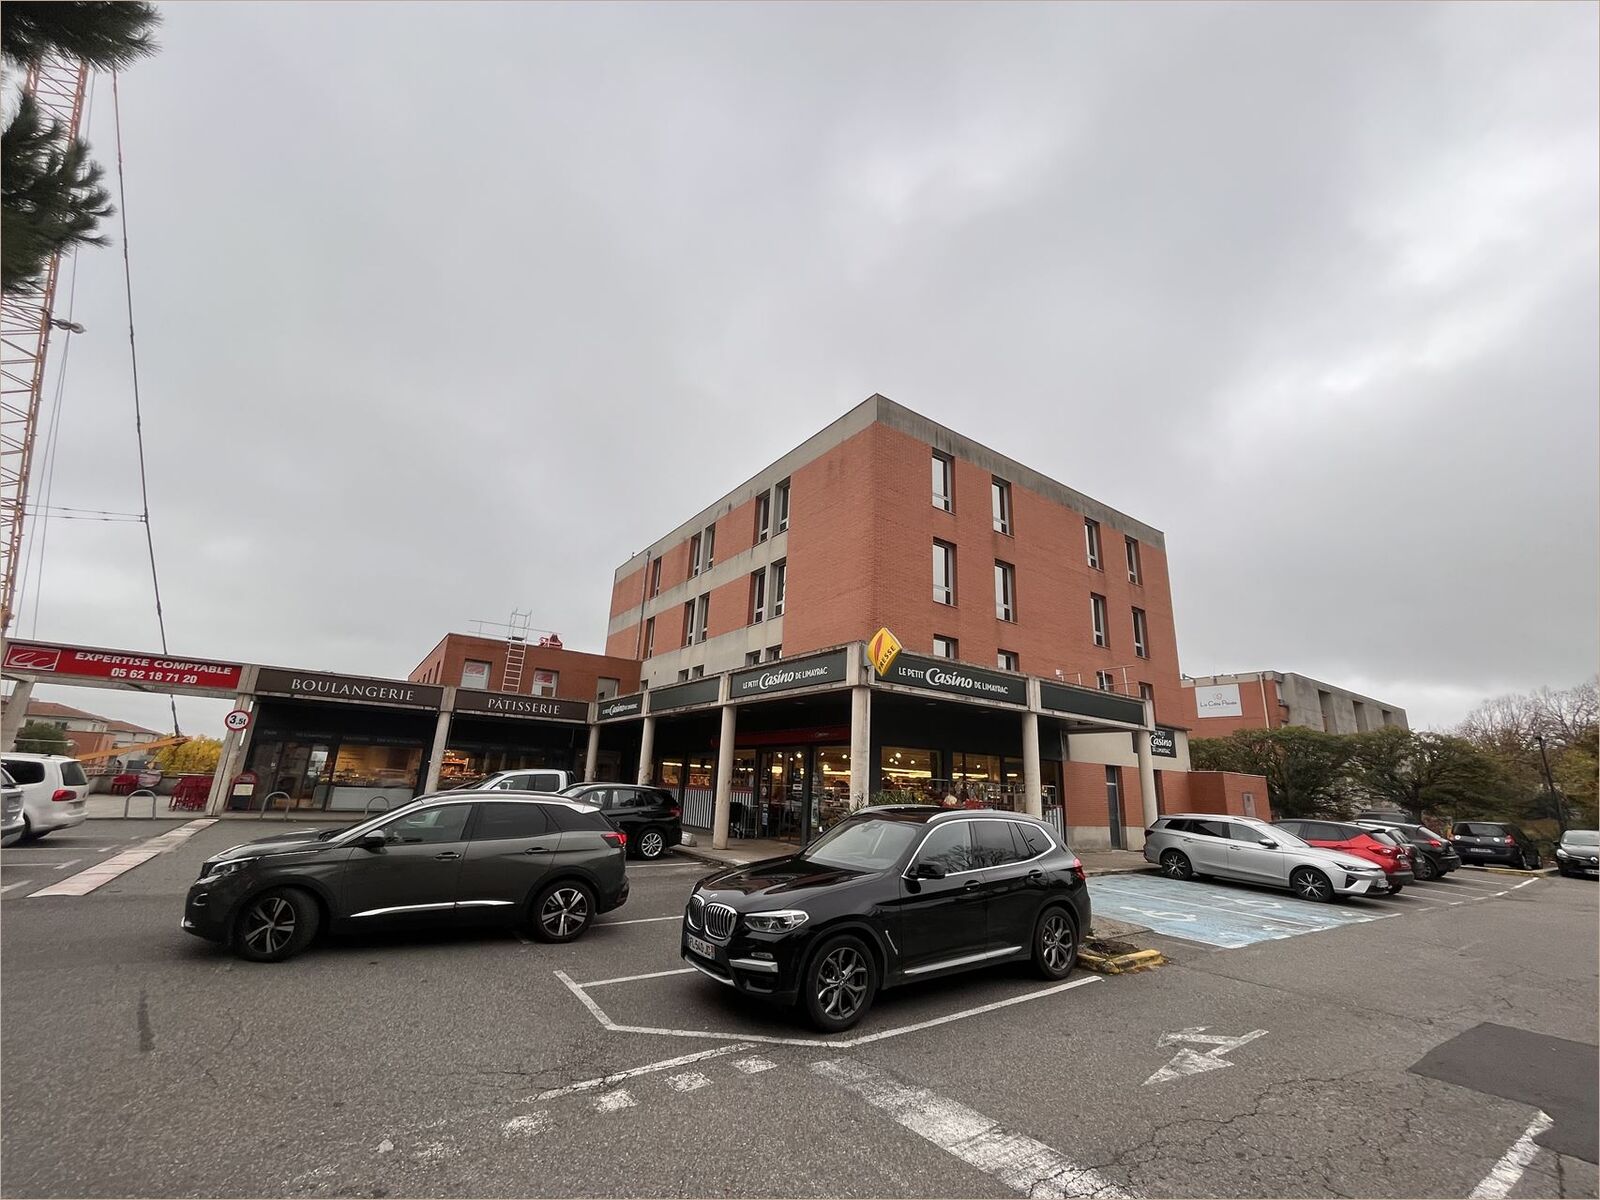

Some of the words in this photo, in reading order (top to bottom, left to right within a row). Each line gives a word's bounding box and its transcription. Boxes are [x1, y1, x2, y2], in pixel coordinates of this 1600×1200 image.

[75, 651, 150, 667] EXPERTISE
[153, 660, 233, 675] COMPTABLE
[111, 667, 127, 678] 05
[129, 669, 146, 680] 62
[148, 671, 162, 681] 18
[166, 672, 180, 682] 71
[183, 674, 198, 684] 20
[759, 669, 794, 690] Casino
[898, 667, 907, 676] LE
[907, 668, 925, 679] PETIT
[925, 667, 972, 689] Casino
[291, 678, 415, 701] BOULANGERIE
[1150, 735, 1172, 747] Casino
